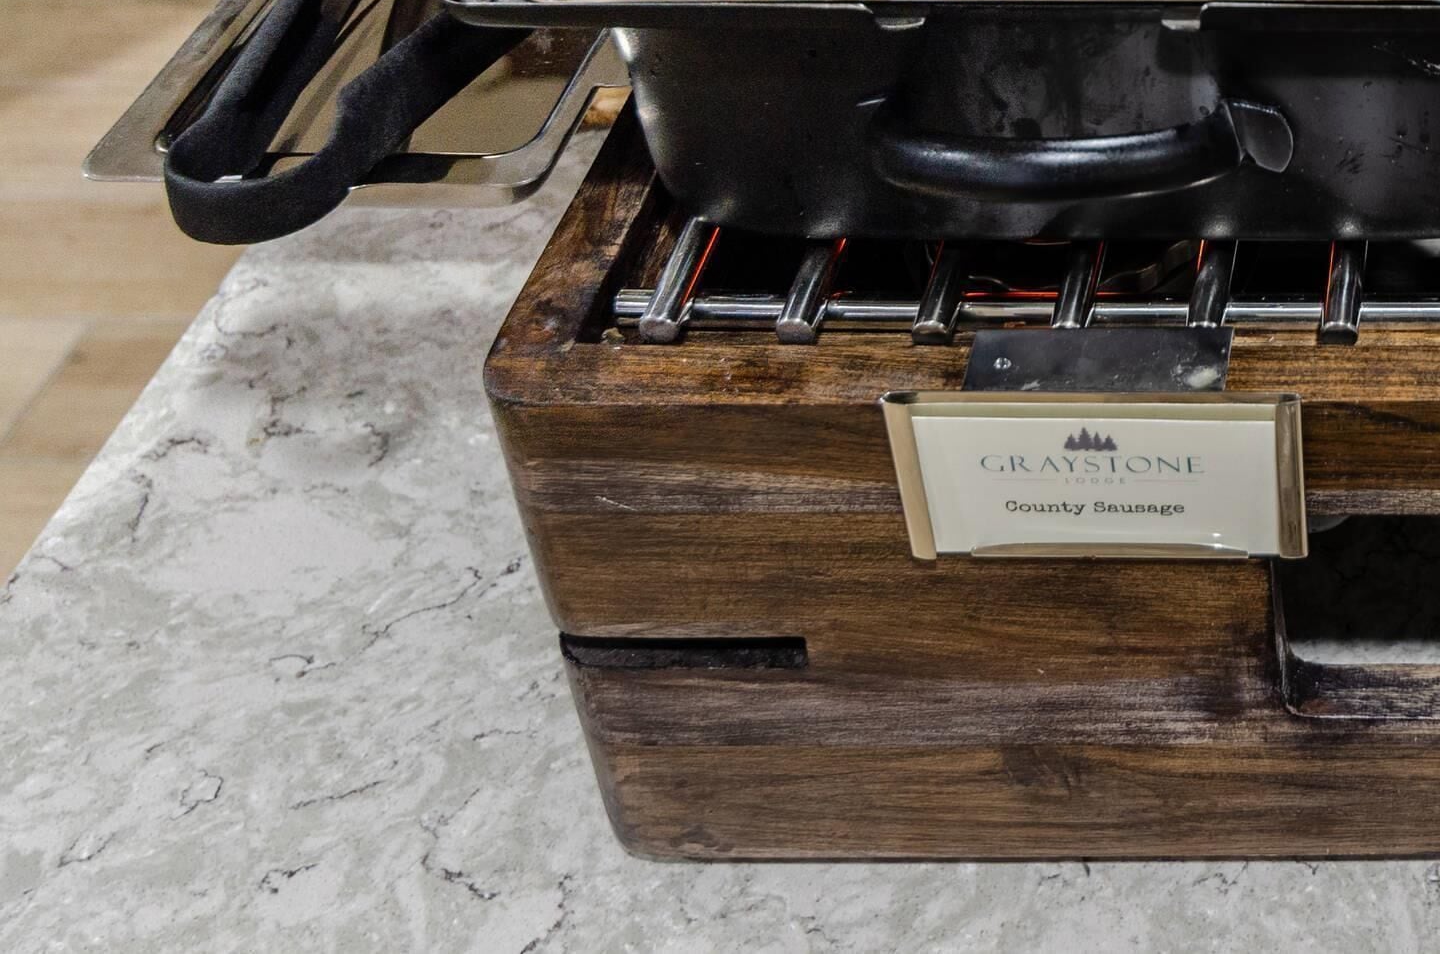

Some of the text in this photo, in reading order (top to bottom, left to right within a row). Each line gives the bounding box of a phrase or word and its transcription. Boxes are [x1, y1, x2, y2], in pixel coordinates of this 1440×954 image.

[980, 454, 1205, 474] GRAYSTONE
[1064, 477, 1128, 485] LODGE
[1005, 500, 1185, 516] County Sausage
